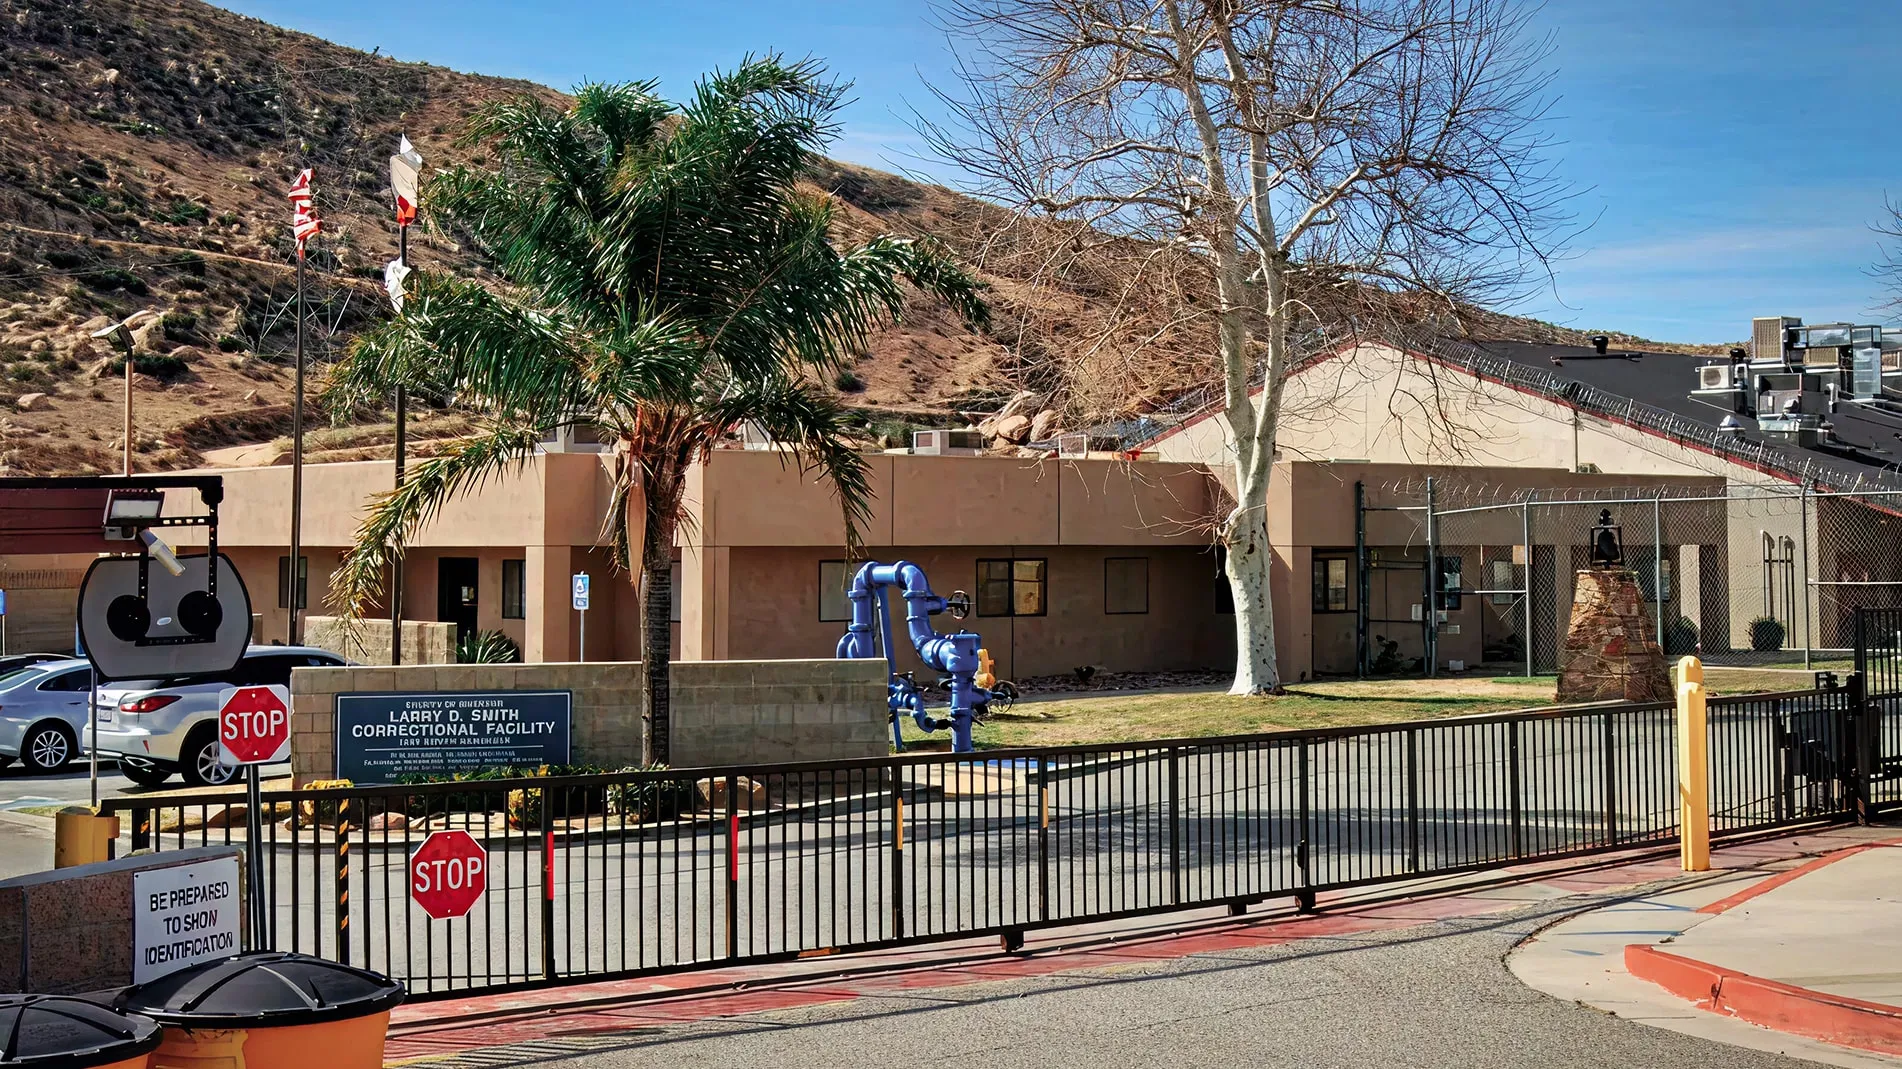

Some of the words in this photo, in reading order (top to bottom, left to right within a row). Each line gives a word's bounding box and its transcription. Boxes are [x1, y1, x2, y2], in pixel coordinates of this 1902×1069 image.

[223, 709, 285, 740] STOP
[389, 710, 443, 723] LARRY
[449, 709, 464, 722] D.
[471, 708, 519, 721] SMITH
[352, 723, 479, 738] CORRECTIONAL
[486, 721, 556, 735] FACILITY
[415, 856, 483, 893] STOP
[150, 892, 168, 912] BE
[163, 916, 181, 935] TO
